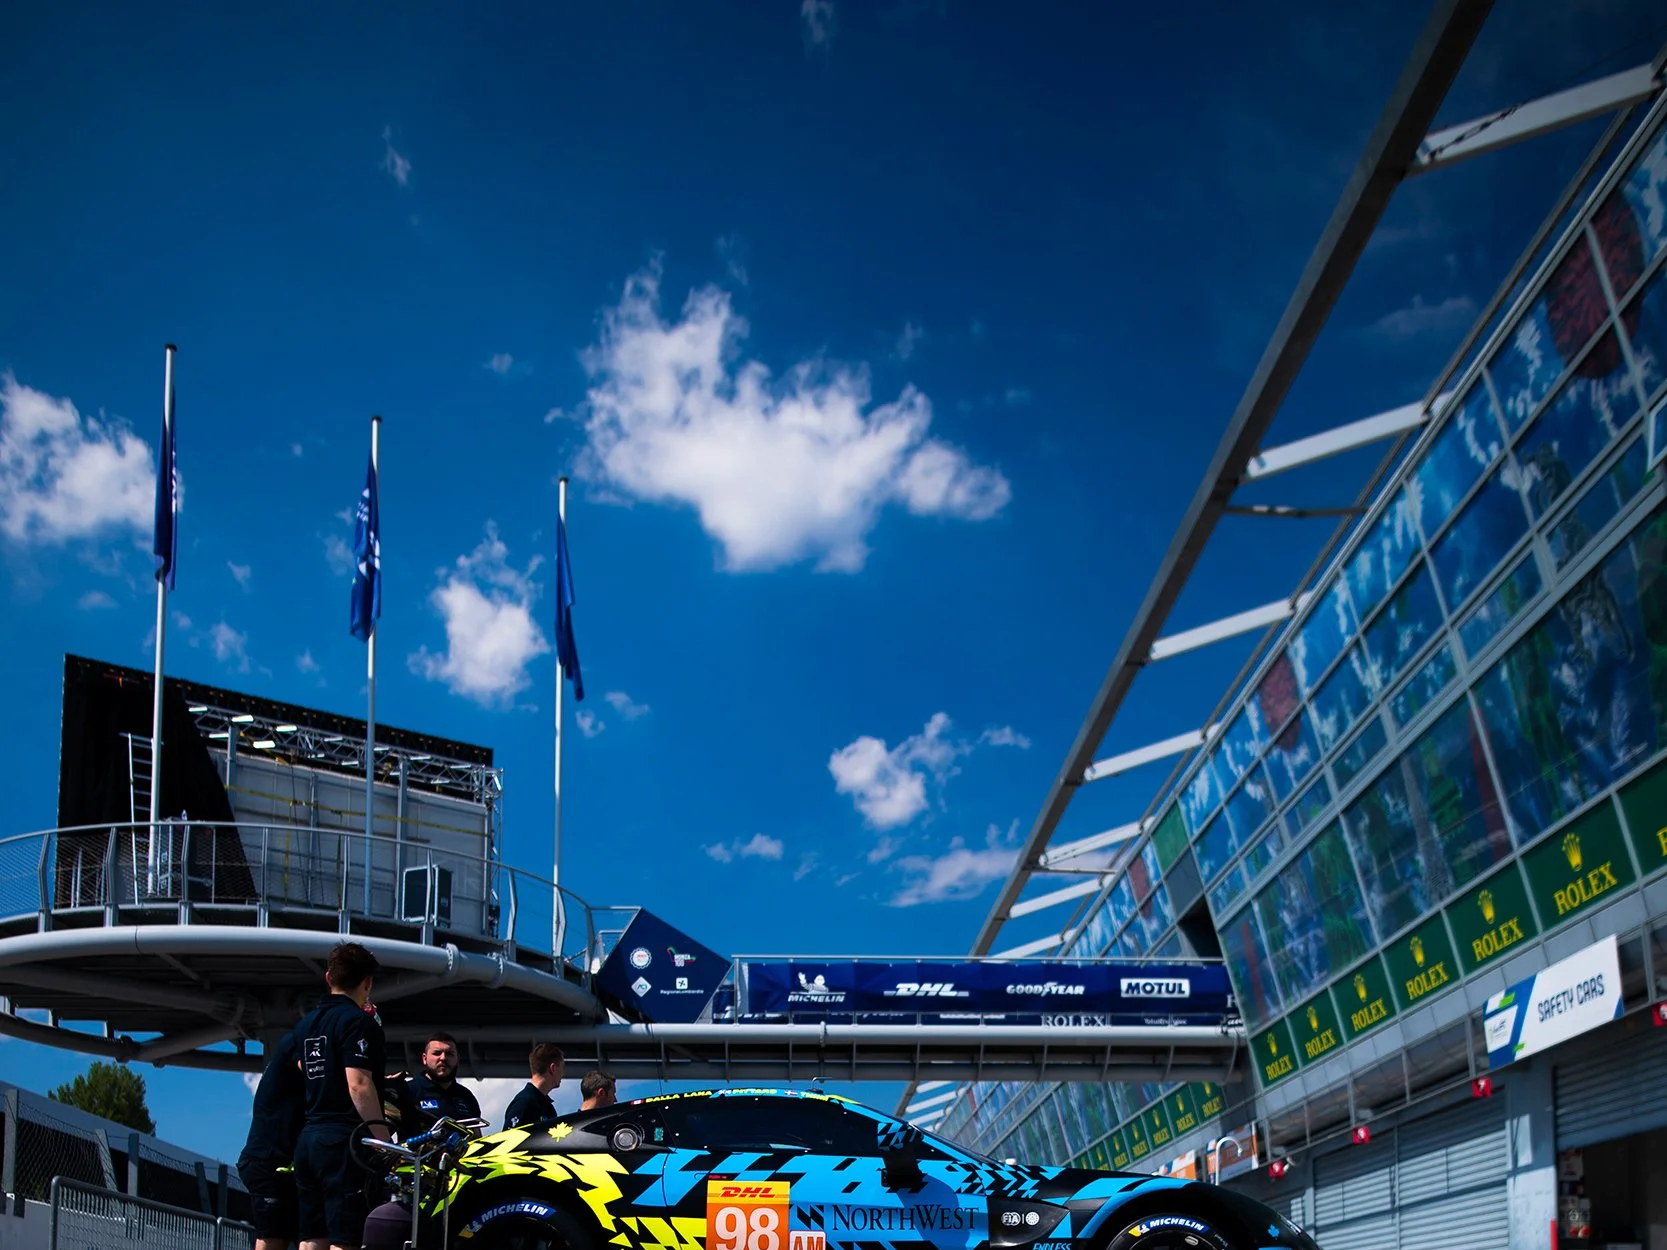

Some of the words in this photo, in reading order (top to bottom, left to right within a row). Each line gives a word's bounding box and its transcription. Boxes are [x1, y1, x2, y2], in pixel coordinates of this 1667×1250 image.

[1553, 860, 1618, 916] ROLEX
[1472, 917, 1524, 961] ROLEX
[895, 983, 958, 997] DHL
[1006, 982, 1085, 997] GOODYEAR
[1123, 982, 1186, 994] MOTUL
[1406, 961, 1449, 1000] ROLEX
[788, 994, 846, 1003] MICHELIN
[1537, 987, 1574, 1023] SAFETY
[1576, 974, 1605, 1005] CARS
[1041, 1015, 1106, 1027] ROLEX
[1351, 998, 1388, 1032] ROLEX
[1305, 1028, 1336, 1059] ROLEX
[1265, 1055, 1293, 1081] ROLEX
[720, 1186, 776, 1198] DHL
[481, 1203, 549, 1223] MICHELIN
[1150, 1217, 1205, 1231] MICHELIN
